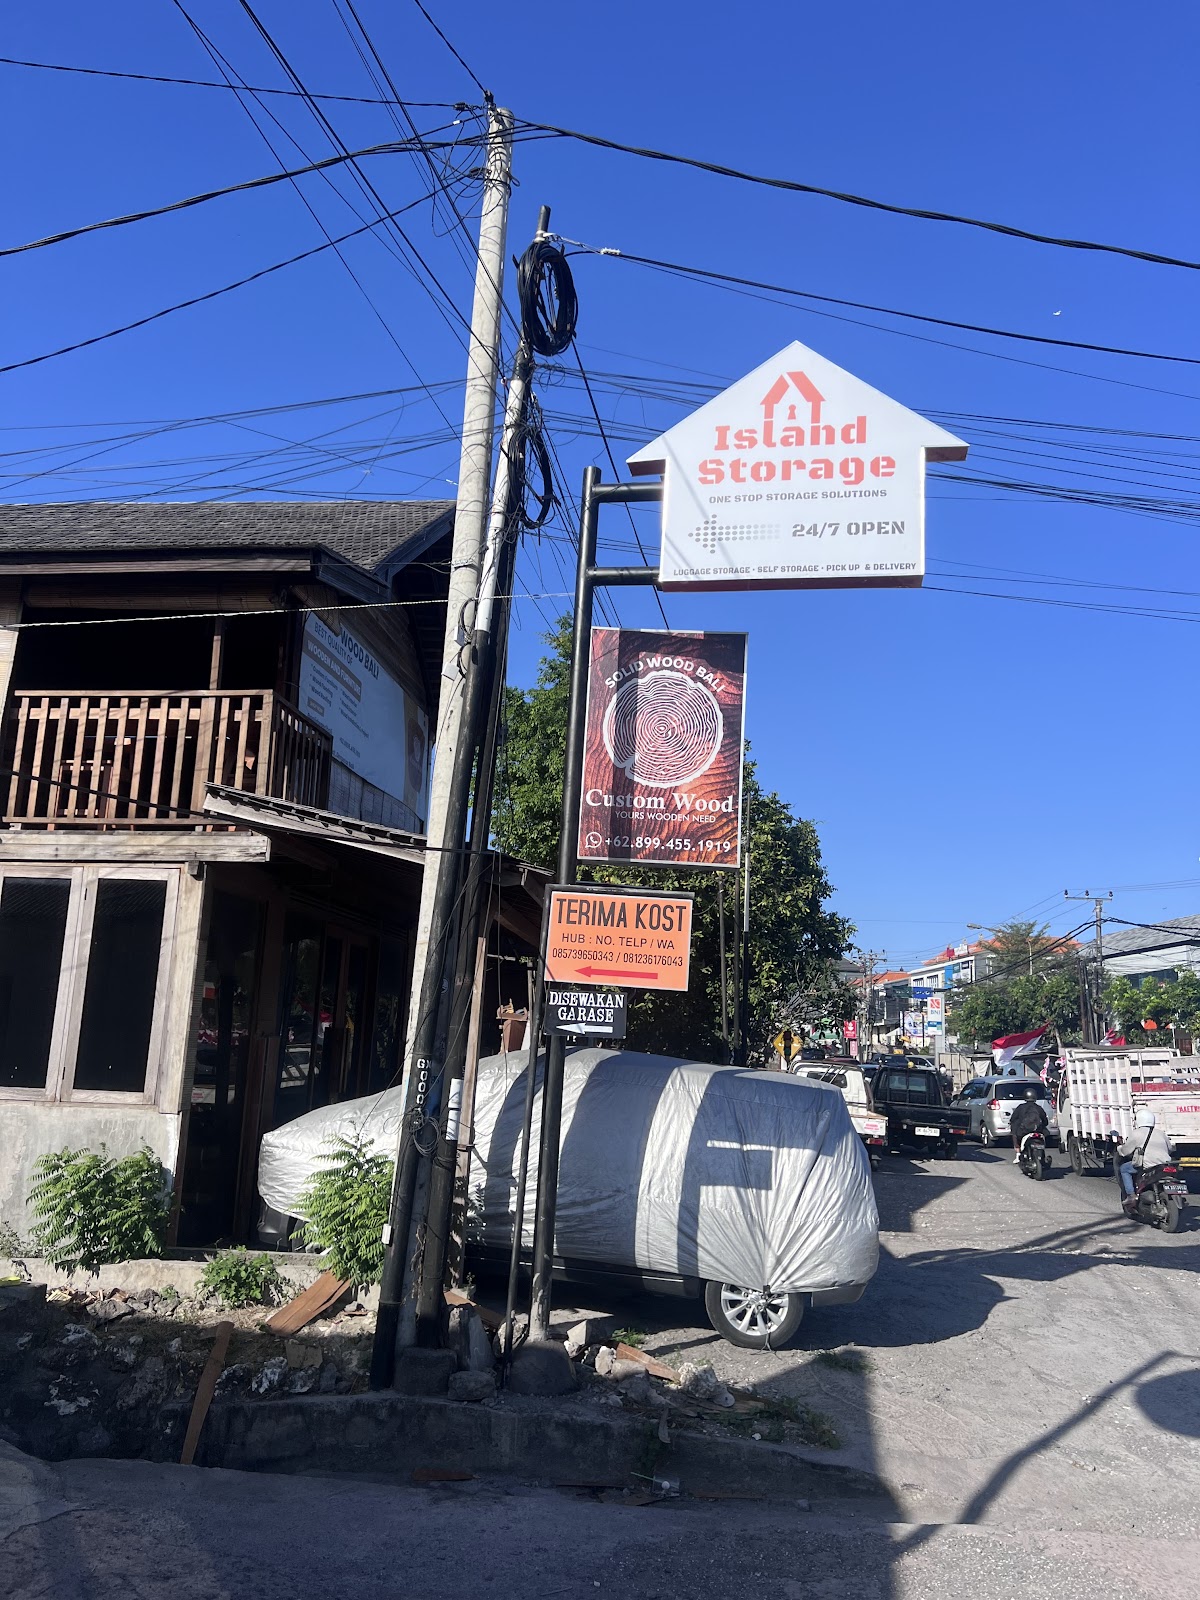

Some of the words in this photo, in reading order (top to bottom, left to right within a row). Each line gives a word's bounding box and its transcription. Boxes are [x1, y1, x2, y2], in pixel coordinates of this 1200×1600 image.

[714, 415, 867, 451] Island
[698, 455, 896, 485] Storage
[708, 495, 732, 504] ONE
[734, 494, 763, 503] STOP
[766, 491, 818, 502] STORAGE
[821, 488, 887, 500] SOLUTIONS
[792, 522, 841, 538] 24/7
[846, 520, 905, 536] OPEN
[673, 567, 712, 576] LUGGAGE
[712, 566, 751, 575] STORAGE
[757, 565, 779, 574] SELF
[780, 564, 820, 573] STORAGE
[826, 564, 847, 572] PICK
[848, 564, 861, 572] UP
[873, 562, 917, 571] DELIVERY
[314, 622, 328, 640] BEST
[328, 635, 346, 660] QUALITY
[340, 627, 364, 663] WOOD
[364, 654, 380, 680] BALI
[605, 659, 645, 689] SOLID
[646, 656, 695, 671] WOOD
[695, 666, 726, 693] BALI
[586, 789, 666, 810] Custom
[672, 792, 734, 812] Wood
[614, 810, 646, 820] YOURS
[646, 812, 690, 822] WOODEN
[692, 813, 716, 823] NEED
[605, 836, 731, 852] +62.899.455.1919
[556, 898, 628, 928] TERIMA
[635, 903, 686, 932] KOST
[562, 933, 585, 944] HUB
[596, 936, 615, 946] NO.
[619, 936, 647, 948] TELP
[656, 940, 675, 950] WA
[552, 948, 614, 962] 085739650343
[624, 953, 683, 966] 081236176043
[549, 992, 624, 1008] DISEWAKAN
[558, 1006, 614, 1022] GARASE
